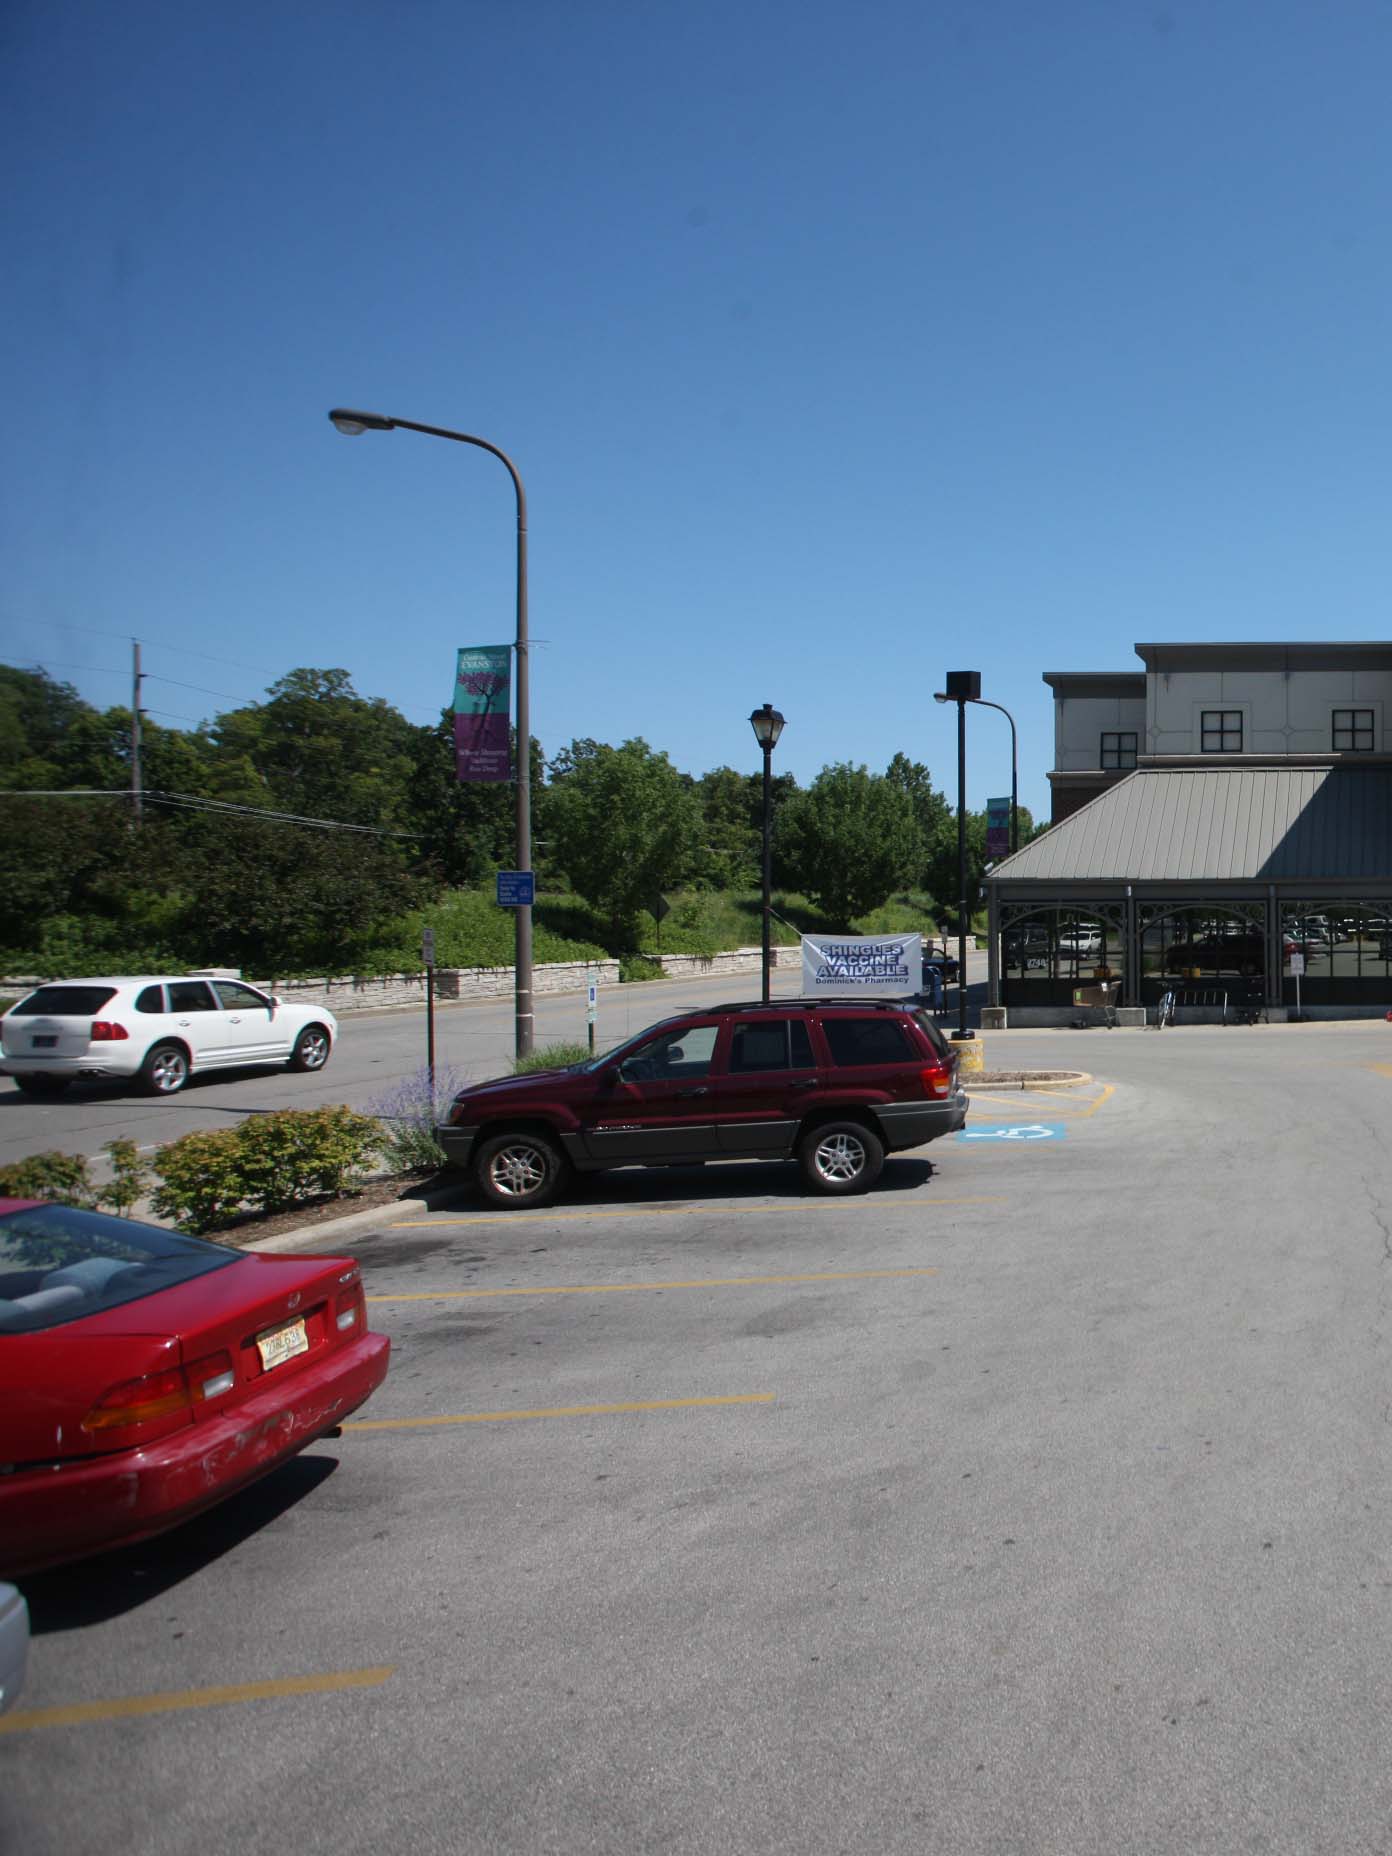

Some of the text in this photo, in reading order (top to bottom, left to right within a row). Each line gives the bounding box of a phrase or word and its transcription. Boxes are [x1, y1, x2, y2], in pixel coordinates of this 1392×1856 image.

[820, 944, 904, 956] SHINGLES
[825, 954, 900, 966] VACCINE
[816, 965, 908, 977] AVAILABLE
[815, 976, 909, 985] Dominick's Pharmacy
